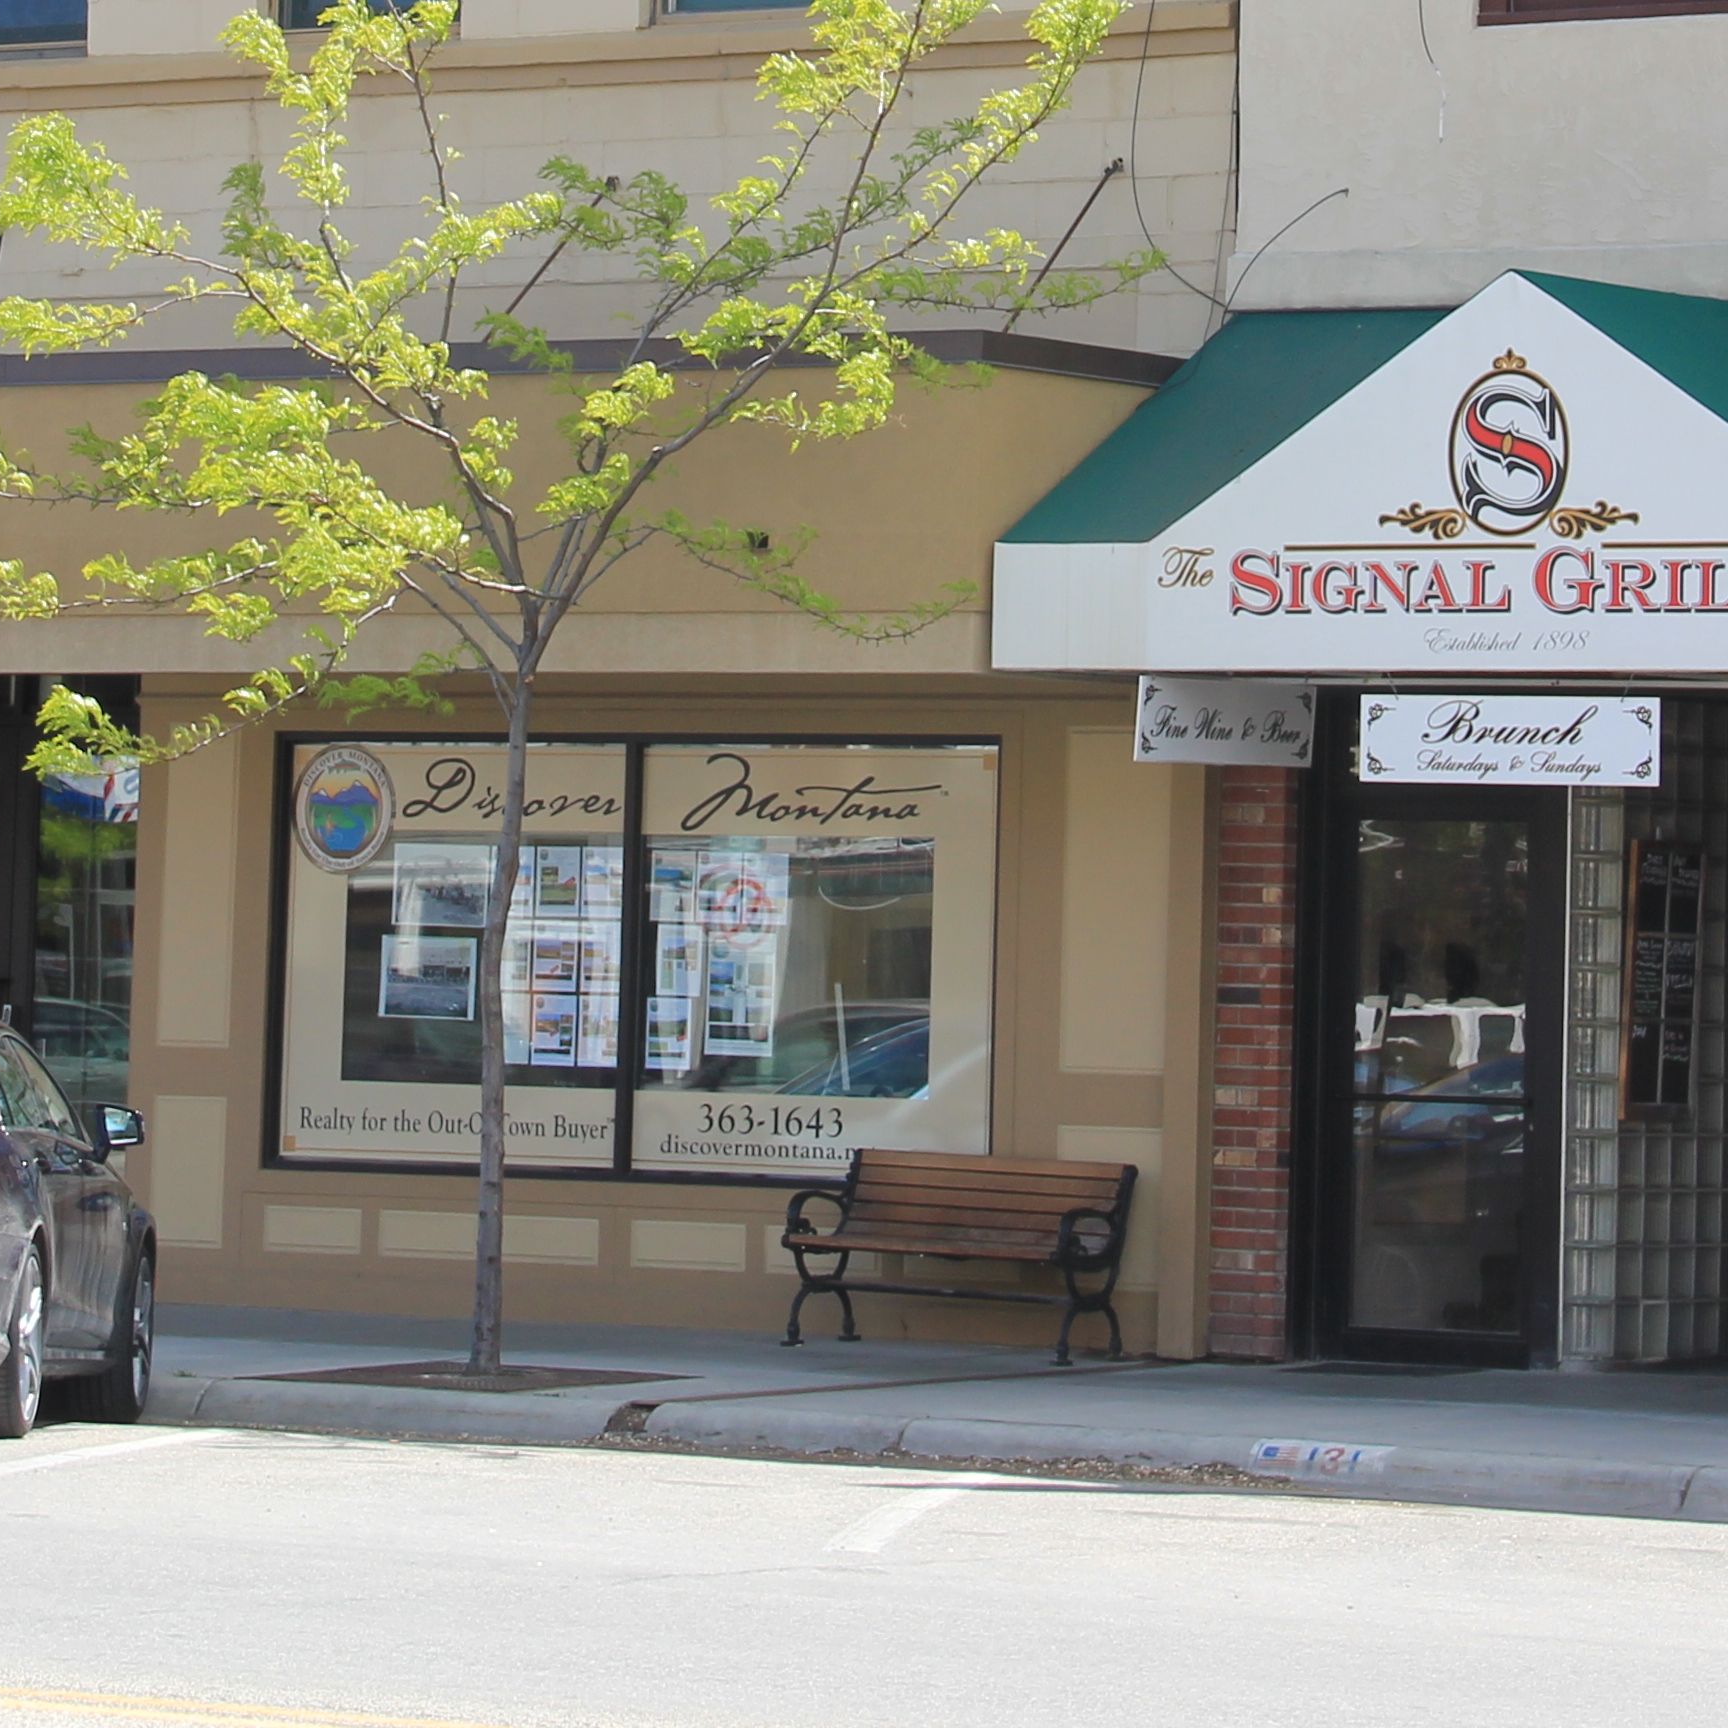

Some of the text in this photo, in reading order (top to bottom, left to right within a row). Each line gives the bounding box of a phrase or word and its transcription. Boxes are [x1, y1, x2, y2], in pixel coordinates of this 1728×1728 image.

[1158, 546, 1215, 590] The
[1228, 548, 1512, 617] SIGNAL
[1422, 628, 1590, 655] Established 1898
[1150, 704, 1302, 745] Fine Wine & Beer
[1421, 699, 1599, 746] Brunch
[303, 751, 389, 789] DISCOVER MONTANA
[1416, 750, 1500, 779] Saturdays
[1530, 750, 1602, 778] Sundays
[681, 753, 942, 831] Montana
[299, 1106, 356, 1136] Realty
[361, 1108, 387, 1132] for
[393, 1110, 421, 1134] the
[553, 1114, 608, 1143] Buyer
[697, 1103, 844, 1139] 363-1643
